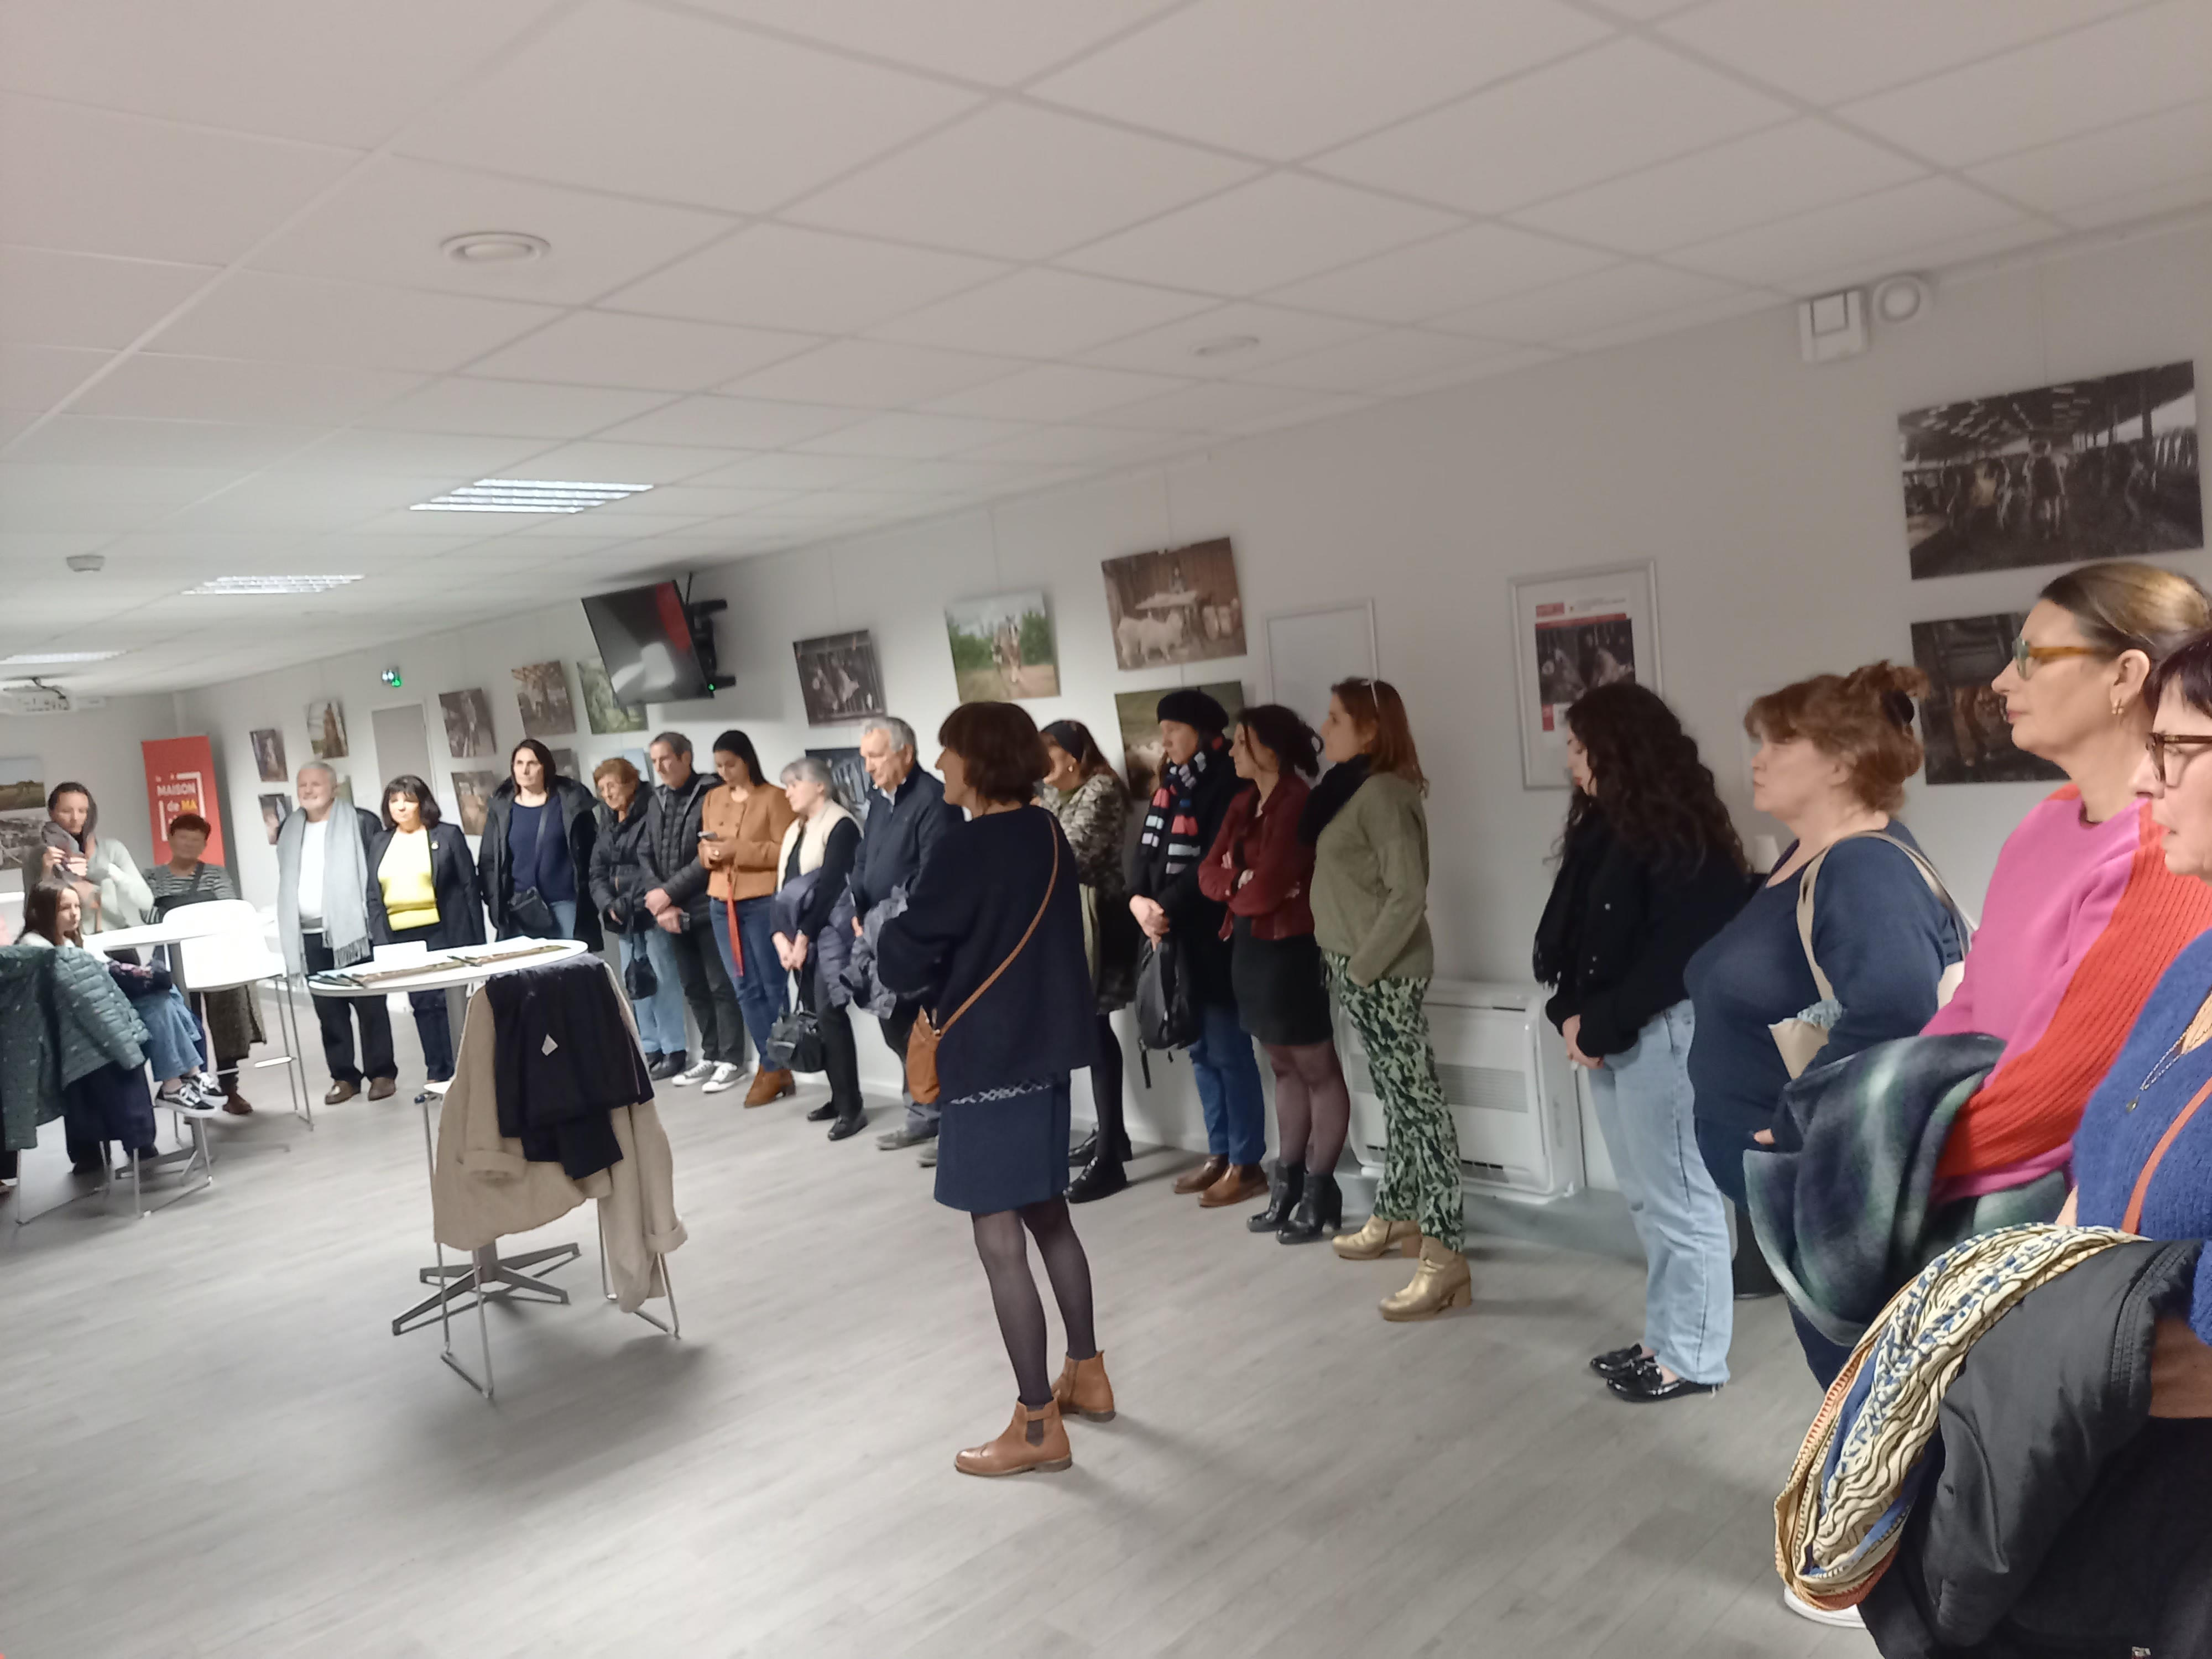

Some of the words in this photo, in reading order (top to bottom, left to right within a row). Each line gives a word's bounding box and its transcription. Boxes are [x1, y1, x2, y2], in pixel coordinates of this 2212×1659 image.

[156, 782, 196, 796] MAISON
[167, 800, 180, 812] de
[181, 799, 197, 811] MA
